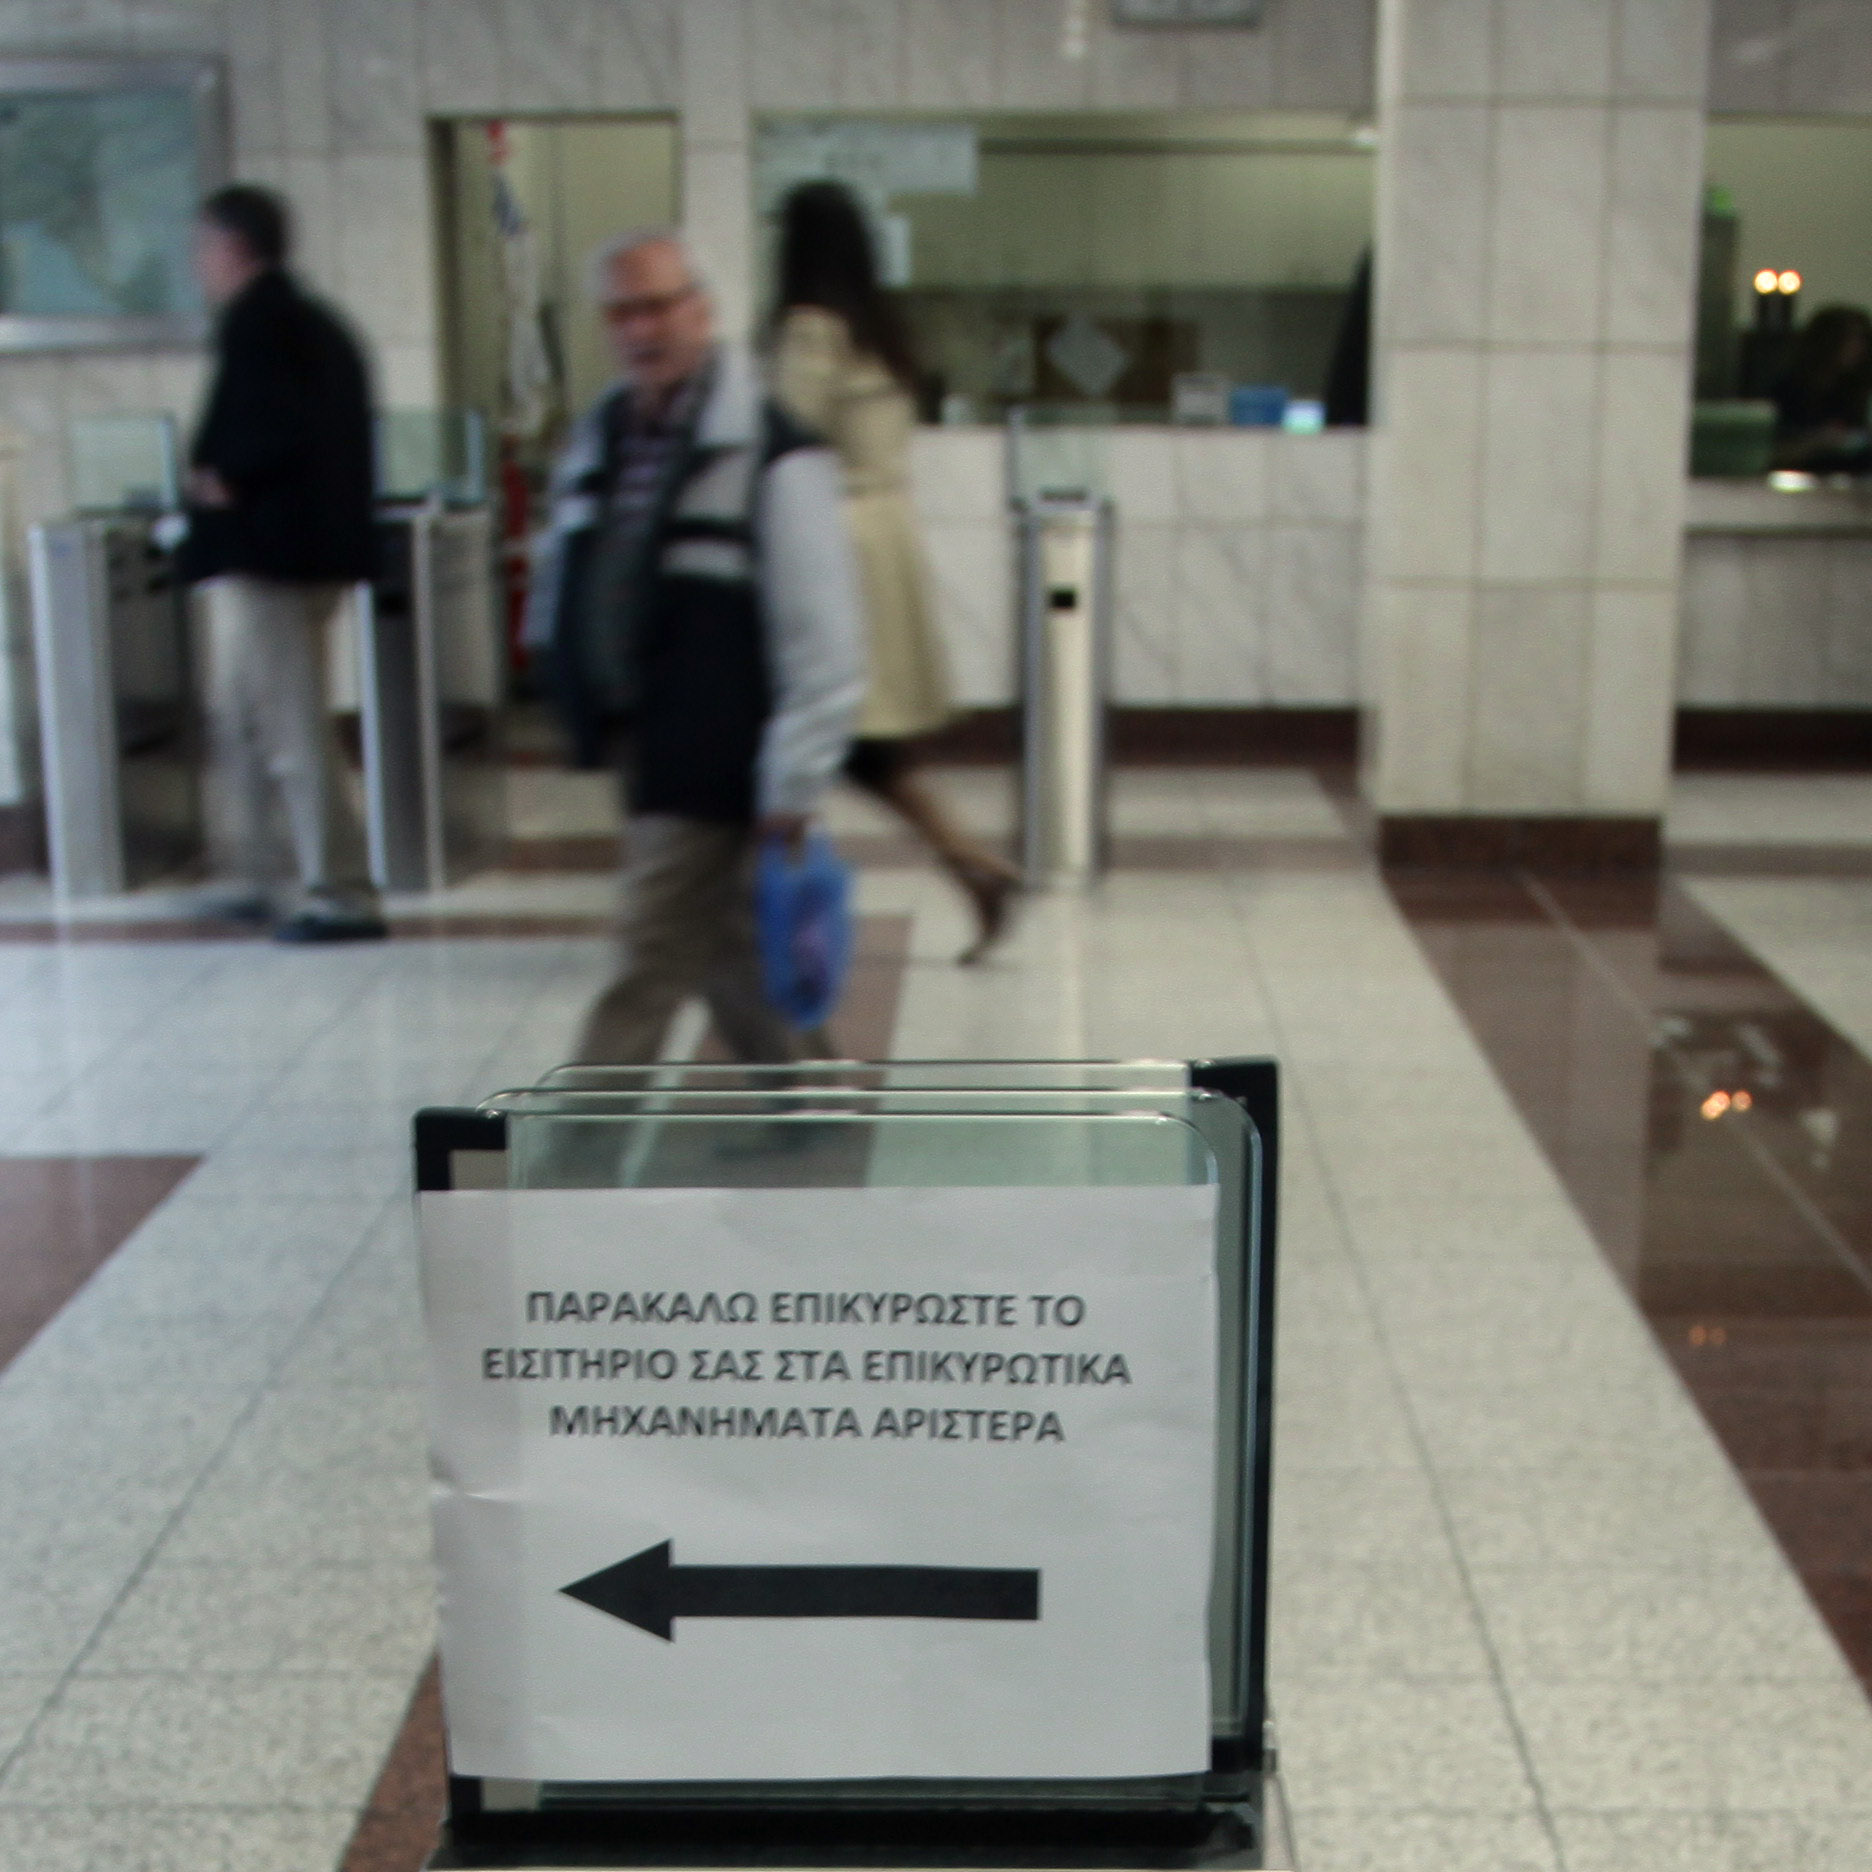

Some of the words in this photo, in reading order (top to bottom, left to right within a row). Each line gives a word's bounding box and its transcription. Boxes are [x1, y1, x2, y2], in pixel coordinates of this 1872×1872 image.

[526, 1291, 757, 1325] ΠΑΡΑΚΑΛΩ
[770, 1293, 1017, 1326] ΕΠΙΚΥΡΩΣΤΕ
[1031, 1295, 1086, 1327] ΤΟ
[482, 1347, 678, 1381] ΕΙΣΙΤΗΡΙΟ
[689, 1349, 764, 1381] ΣΑΣ
[775, 1350, 850, 1382] ΣΤΑ
[863, 1350, 1132, 1385] ΕΠΙΚΥΡΩΤΙΚΑ
[549, 1405, 862, 1439] ΜΗΧΑΝΗΜΑΤΑ
[871, 1407, 1065, 1442] ΑΡΙΣΤΕΡΑ
